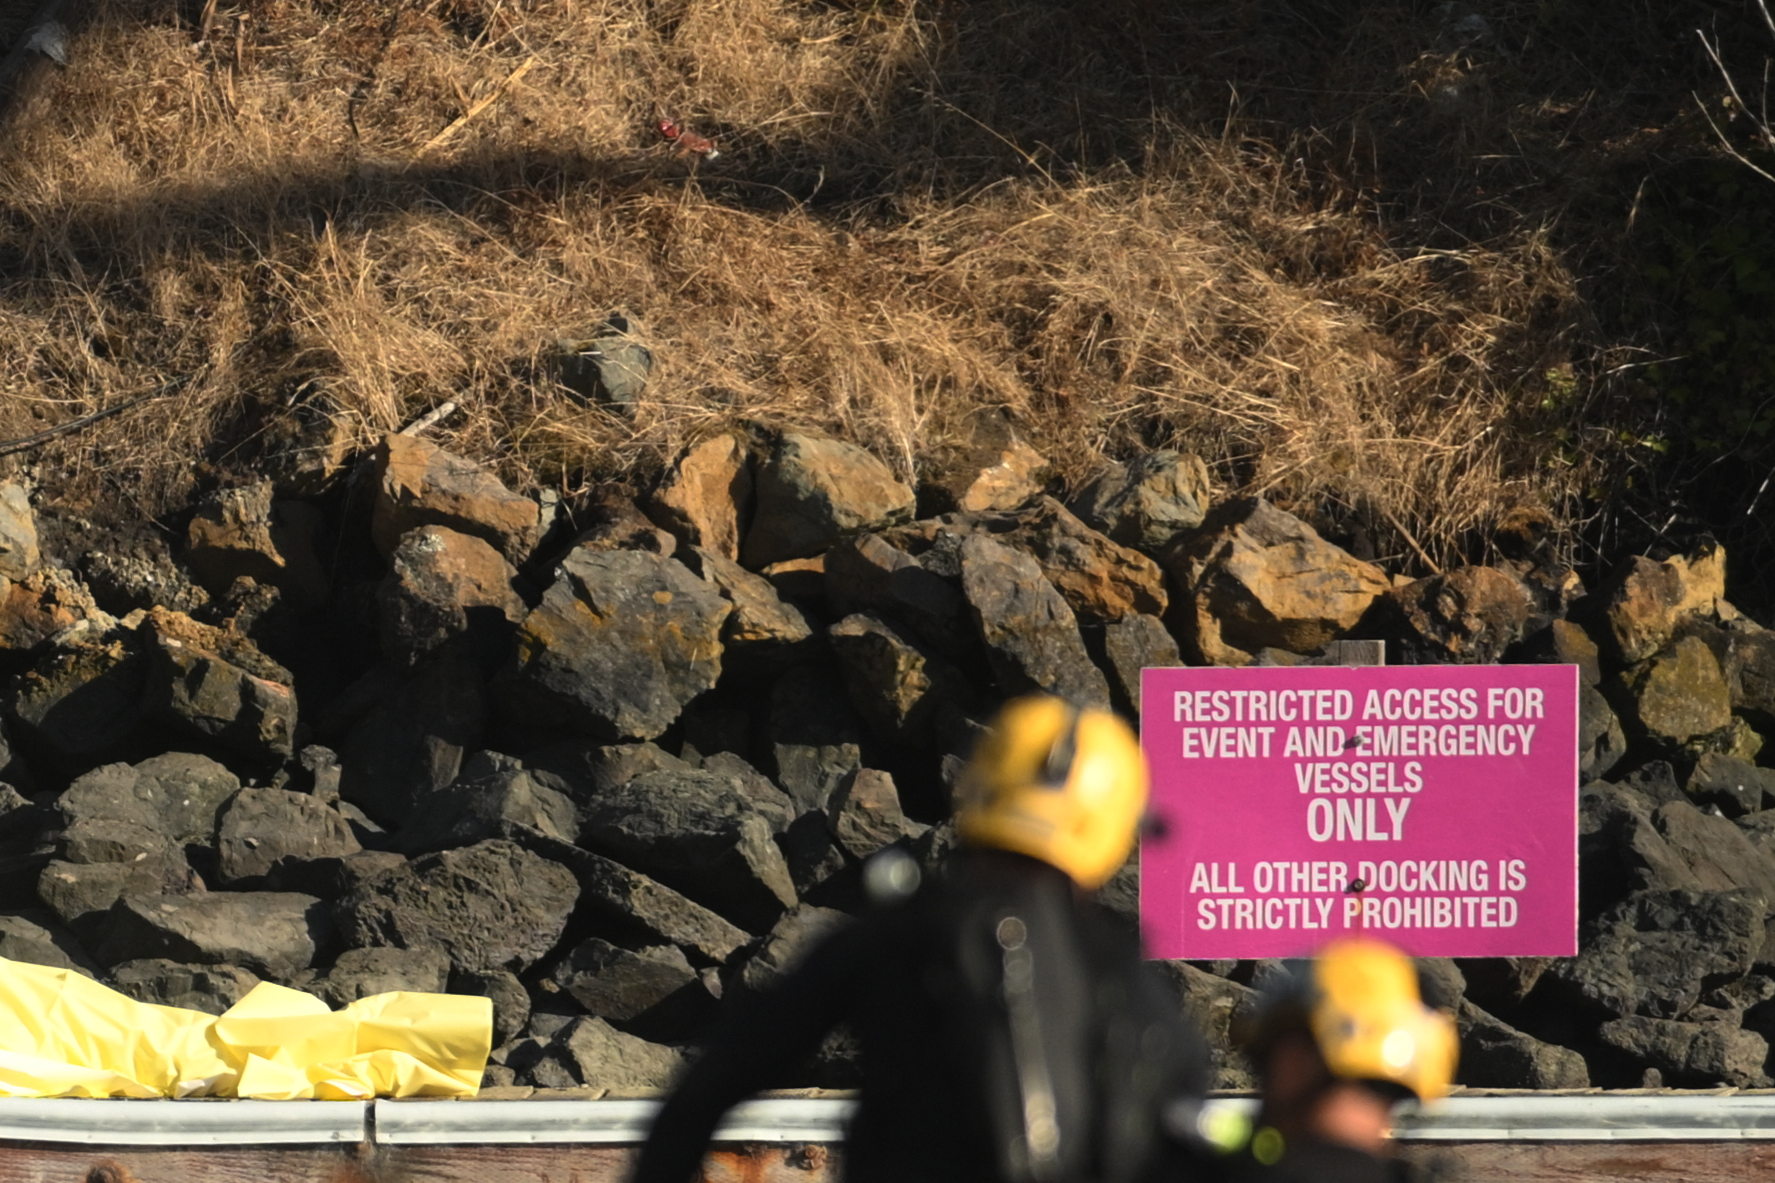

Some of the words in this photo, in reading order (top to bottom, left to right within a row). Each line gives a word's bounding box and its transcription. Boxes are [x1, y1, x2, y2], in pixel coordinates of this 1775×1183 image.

[1173, 689, 1354, 723] RESTRICTED
[1362, 687, 1479, 721] ACCESS
[1487, 687, 1544, 720] FOR
[1182, 726, 1276, 759] EVENT
[1283, 725, 1346, 758] AND
[1355, 724, 1536, 758] EMERGENCY
[1294, 760, 1424, 794] VESSELS
[1306, 797, 1412, 842] ONLY
[1189, 861, 1246, 894] ALL
[1253, 861, 1348, 894] OTHER
[1358, 859, 1489, 893] DOCKING
[1498, 859, 1527, 892] IS
[1197, 898, 1335, 931] STRICTLY
[1343, 896, 1518, 930] PROHIBITED
